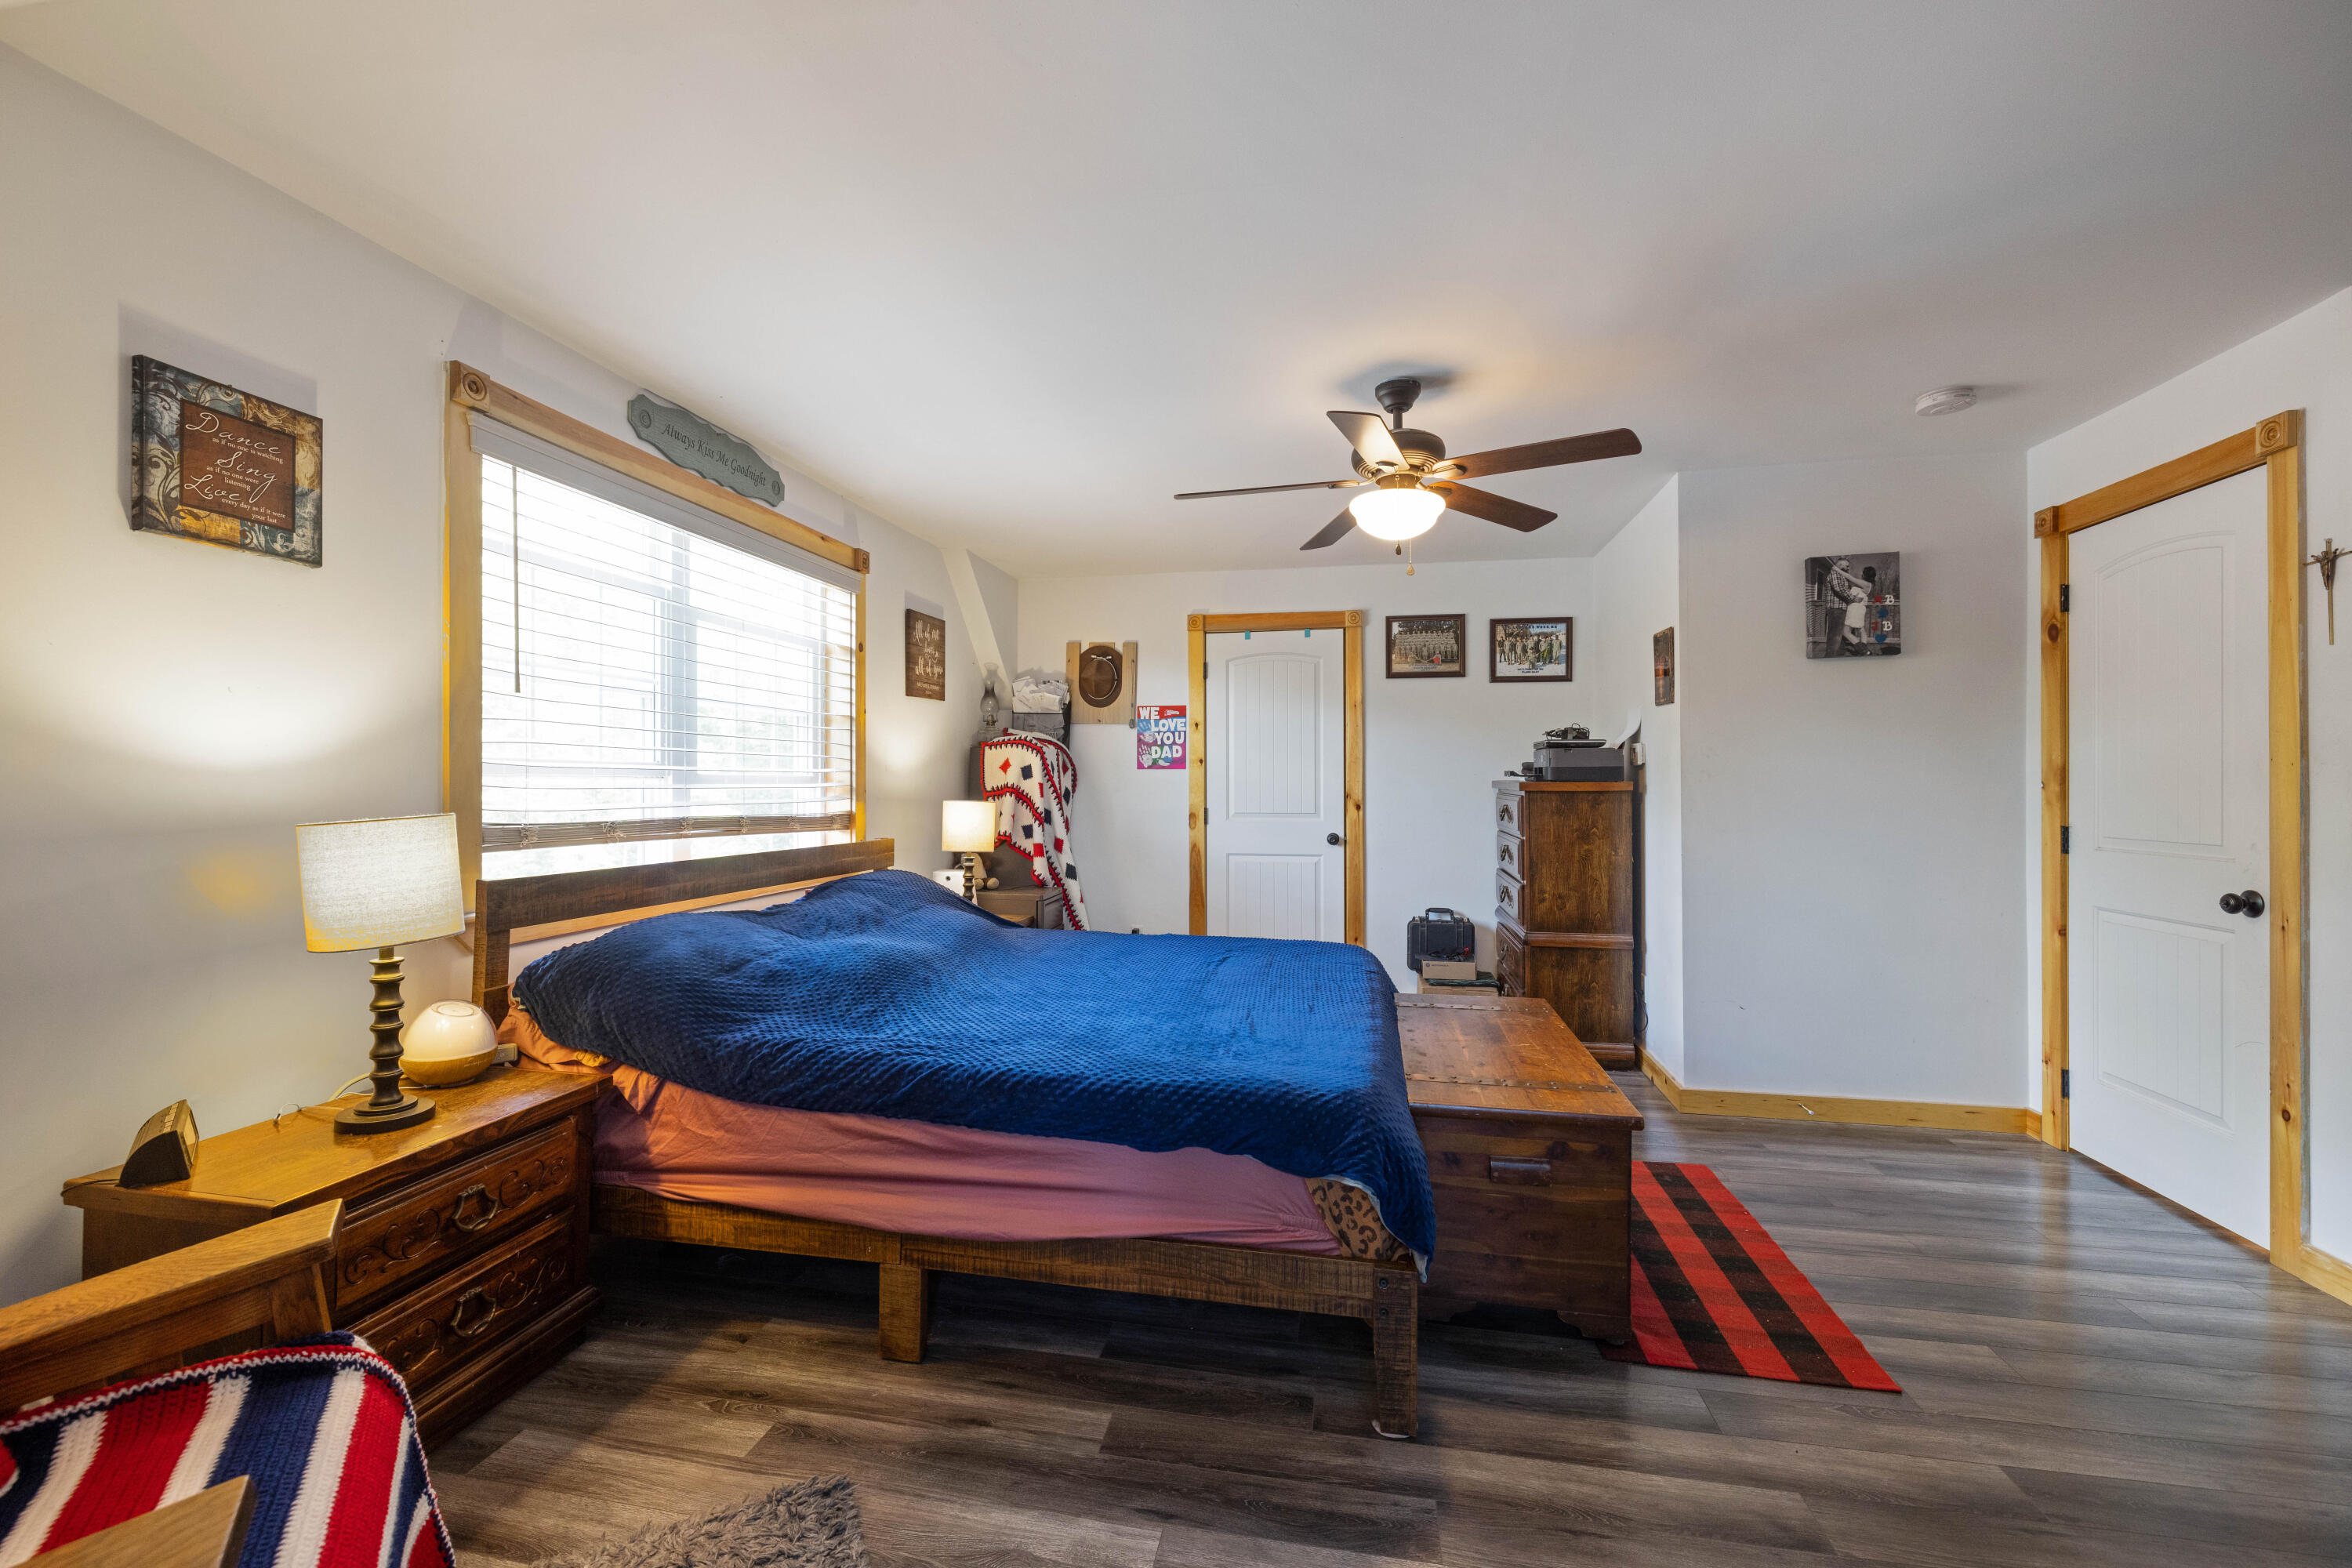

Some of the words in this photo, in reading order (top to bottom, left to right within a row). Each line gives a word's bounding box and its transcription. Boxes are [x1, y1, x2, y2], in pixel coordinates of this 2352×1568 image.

[185, 412, 281, 454] Dance
[256, 451, 283, 464] watching
[662, 422, 695, 450] Always
[697, 439, 715, 459] Kiss
[716, 450, 729, 467] Me
[731, 459, 766, 487] Goodnight
[214, 451, 278, 503] Sing
[224, 476, 251, 492] listening
[184, 474, 242, 500] Live
[221, 498, 238, 508] every
[239, 502, 252, 511] day
[1885, 594, 1895, 604] B
[1882, 620, 1893, 631] B
[1138, 706, 1160, 720] WE
[1151, 718, 1186, 731] LOVE
[1154, 731, 1185, 745] YOU
[1151, 745, 1183, 759] DAD
